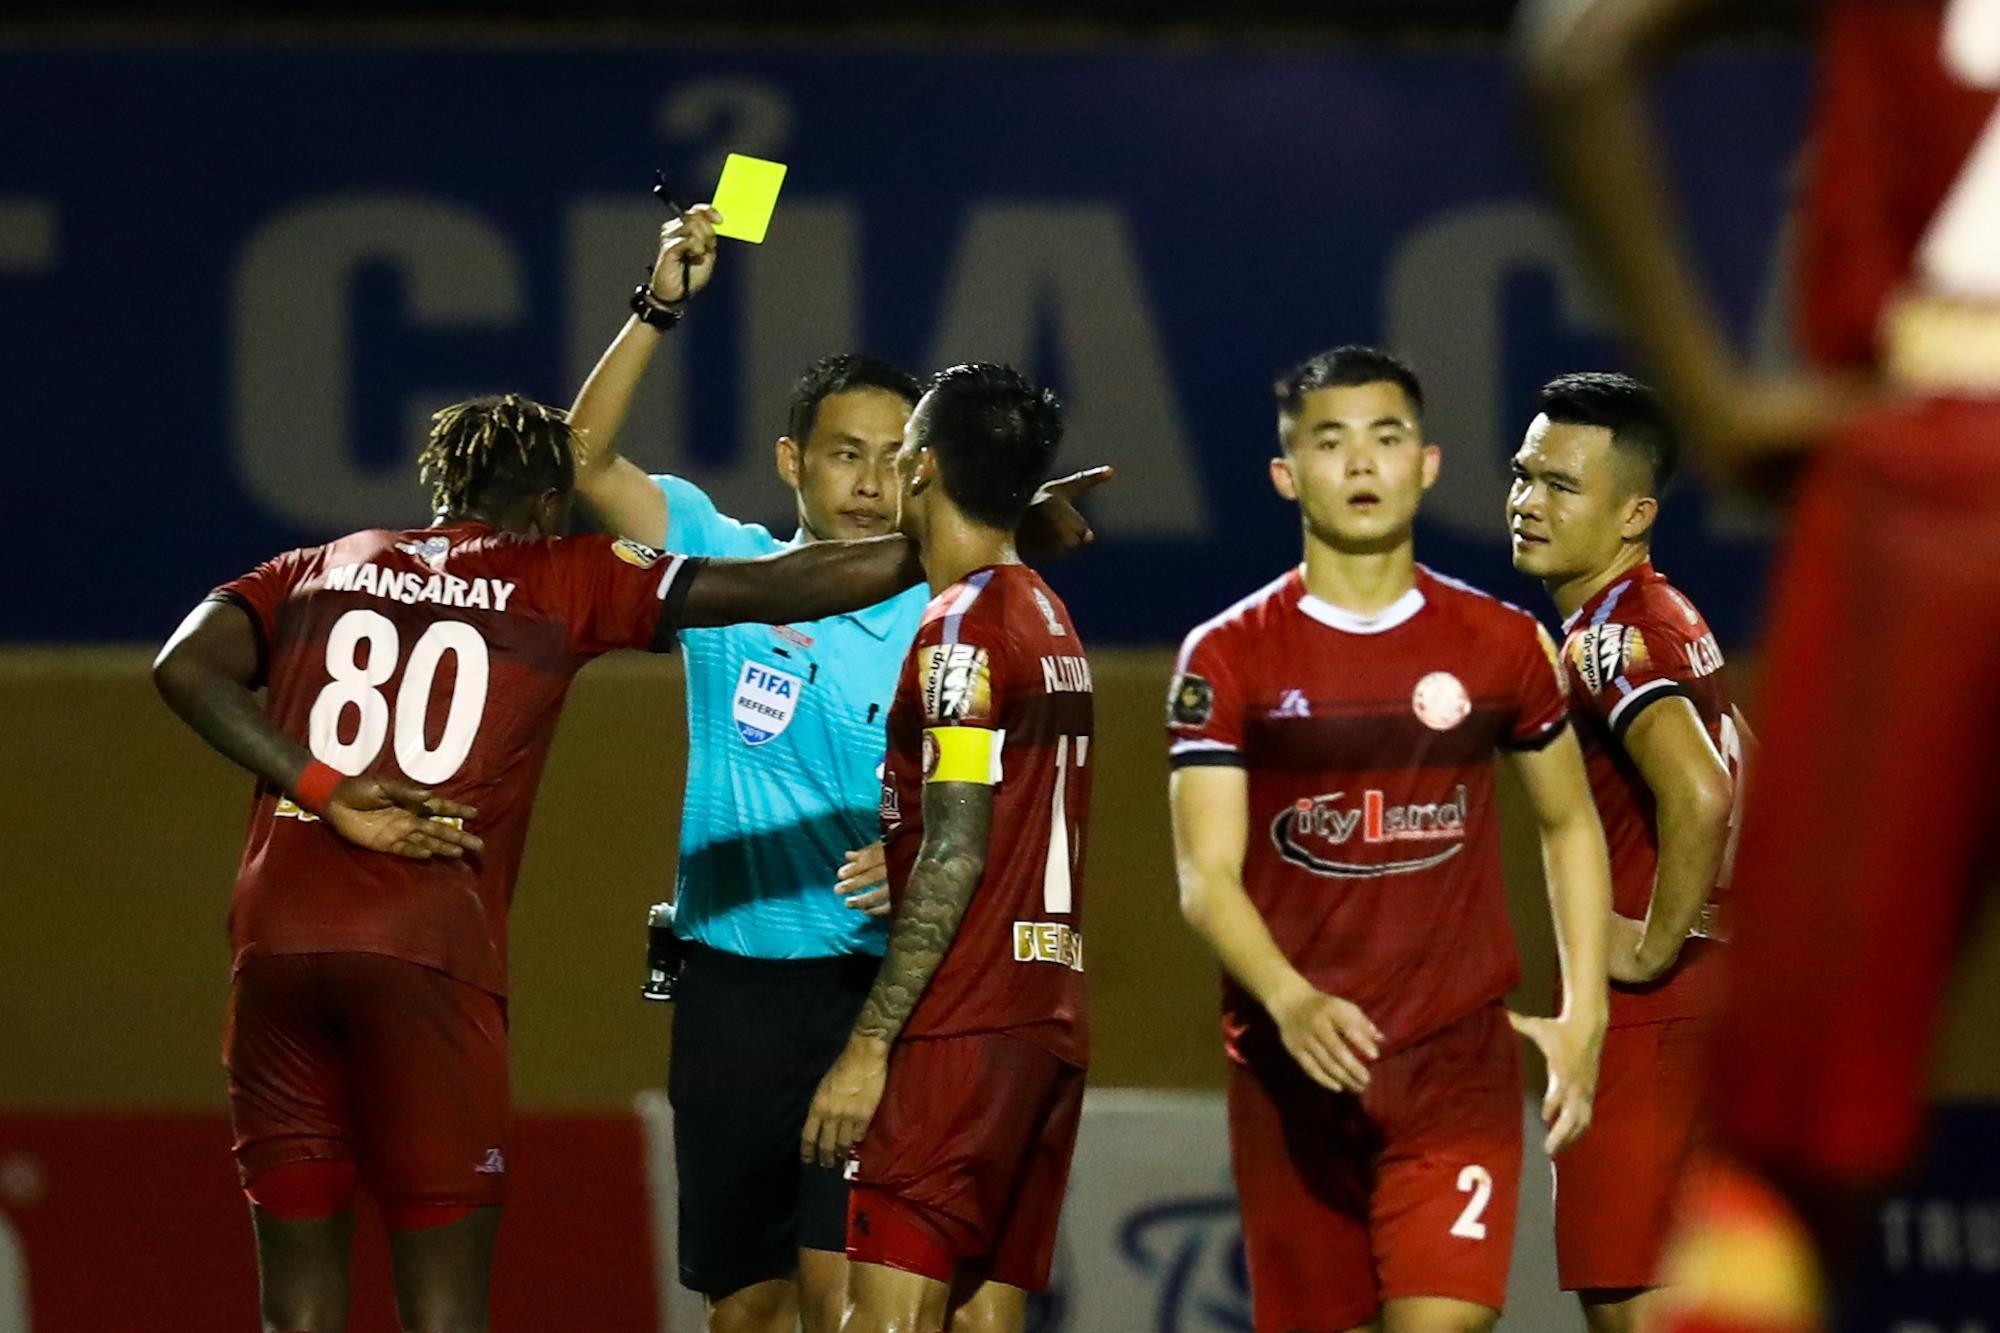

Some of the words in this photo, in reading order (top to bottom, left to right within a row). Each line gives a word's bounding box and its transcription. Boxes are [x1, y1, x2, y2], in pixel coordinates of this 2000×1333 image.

[324, 562, 516, 612] MANSARAY
[308, 609, 491, 786] 80
[738, 695, 786, 721] REFEREE
[744, 665, 791, 699] FIFA
[926, 650, 945, 716] wake-up
[1449, 1164, 1493, 1240] 2
